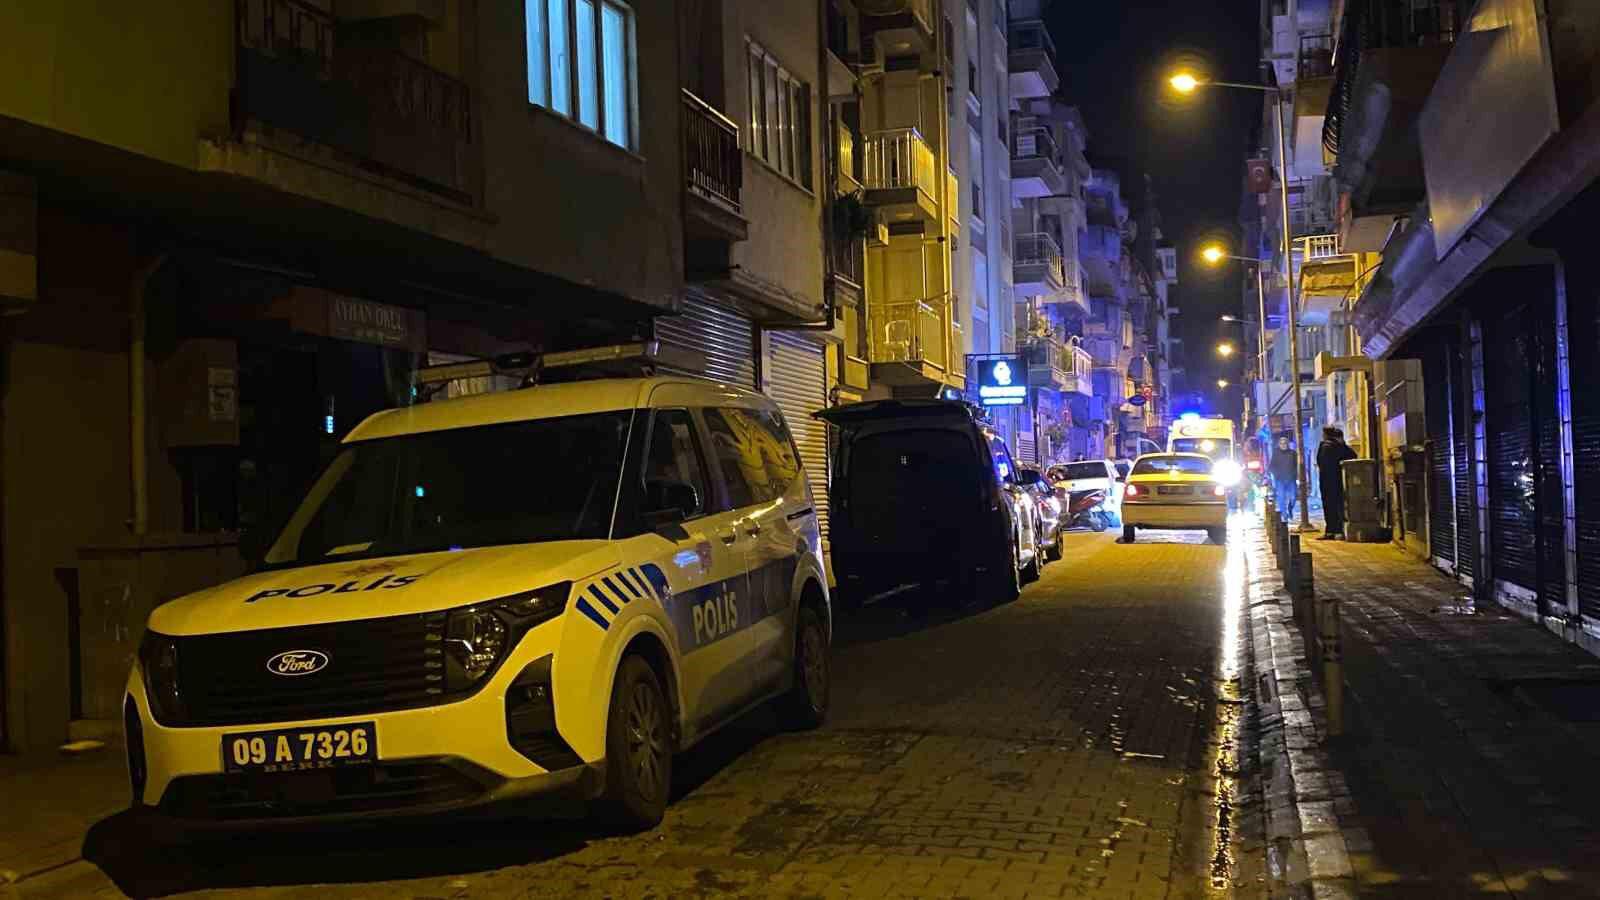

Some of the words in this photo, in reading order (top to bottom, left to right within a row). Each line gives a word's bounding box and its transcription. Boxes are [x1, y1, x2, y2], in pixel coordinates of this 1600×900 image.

[692, 582, 737, 644] POLİS
[278, 654, 316, 673] Ford
[233, 737, 266, 765] 09
[275, 735, 293, 762] A
[300, 728, 369, 760] 7326
